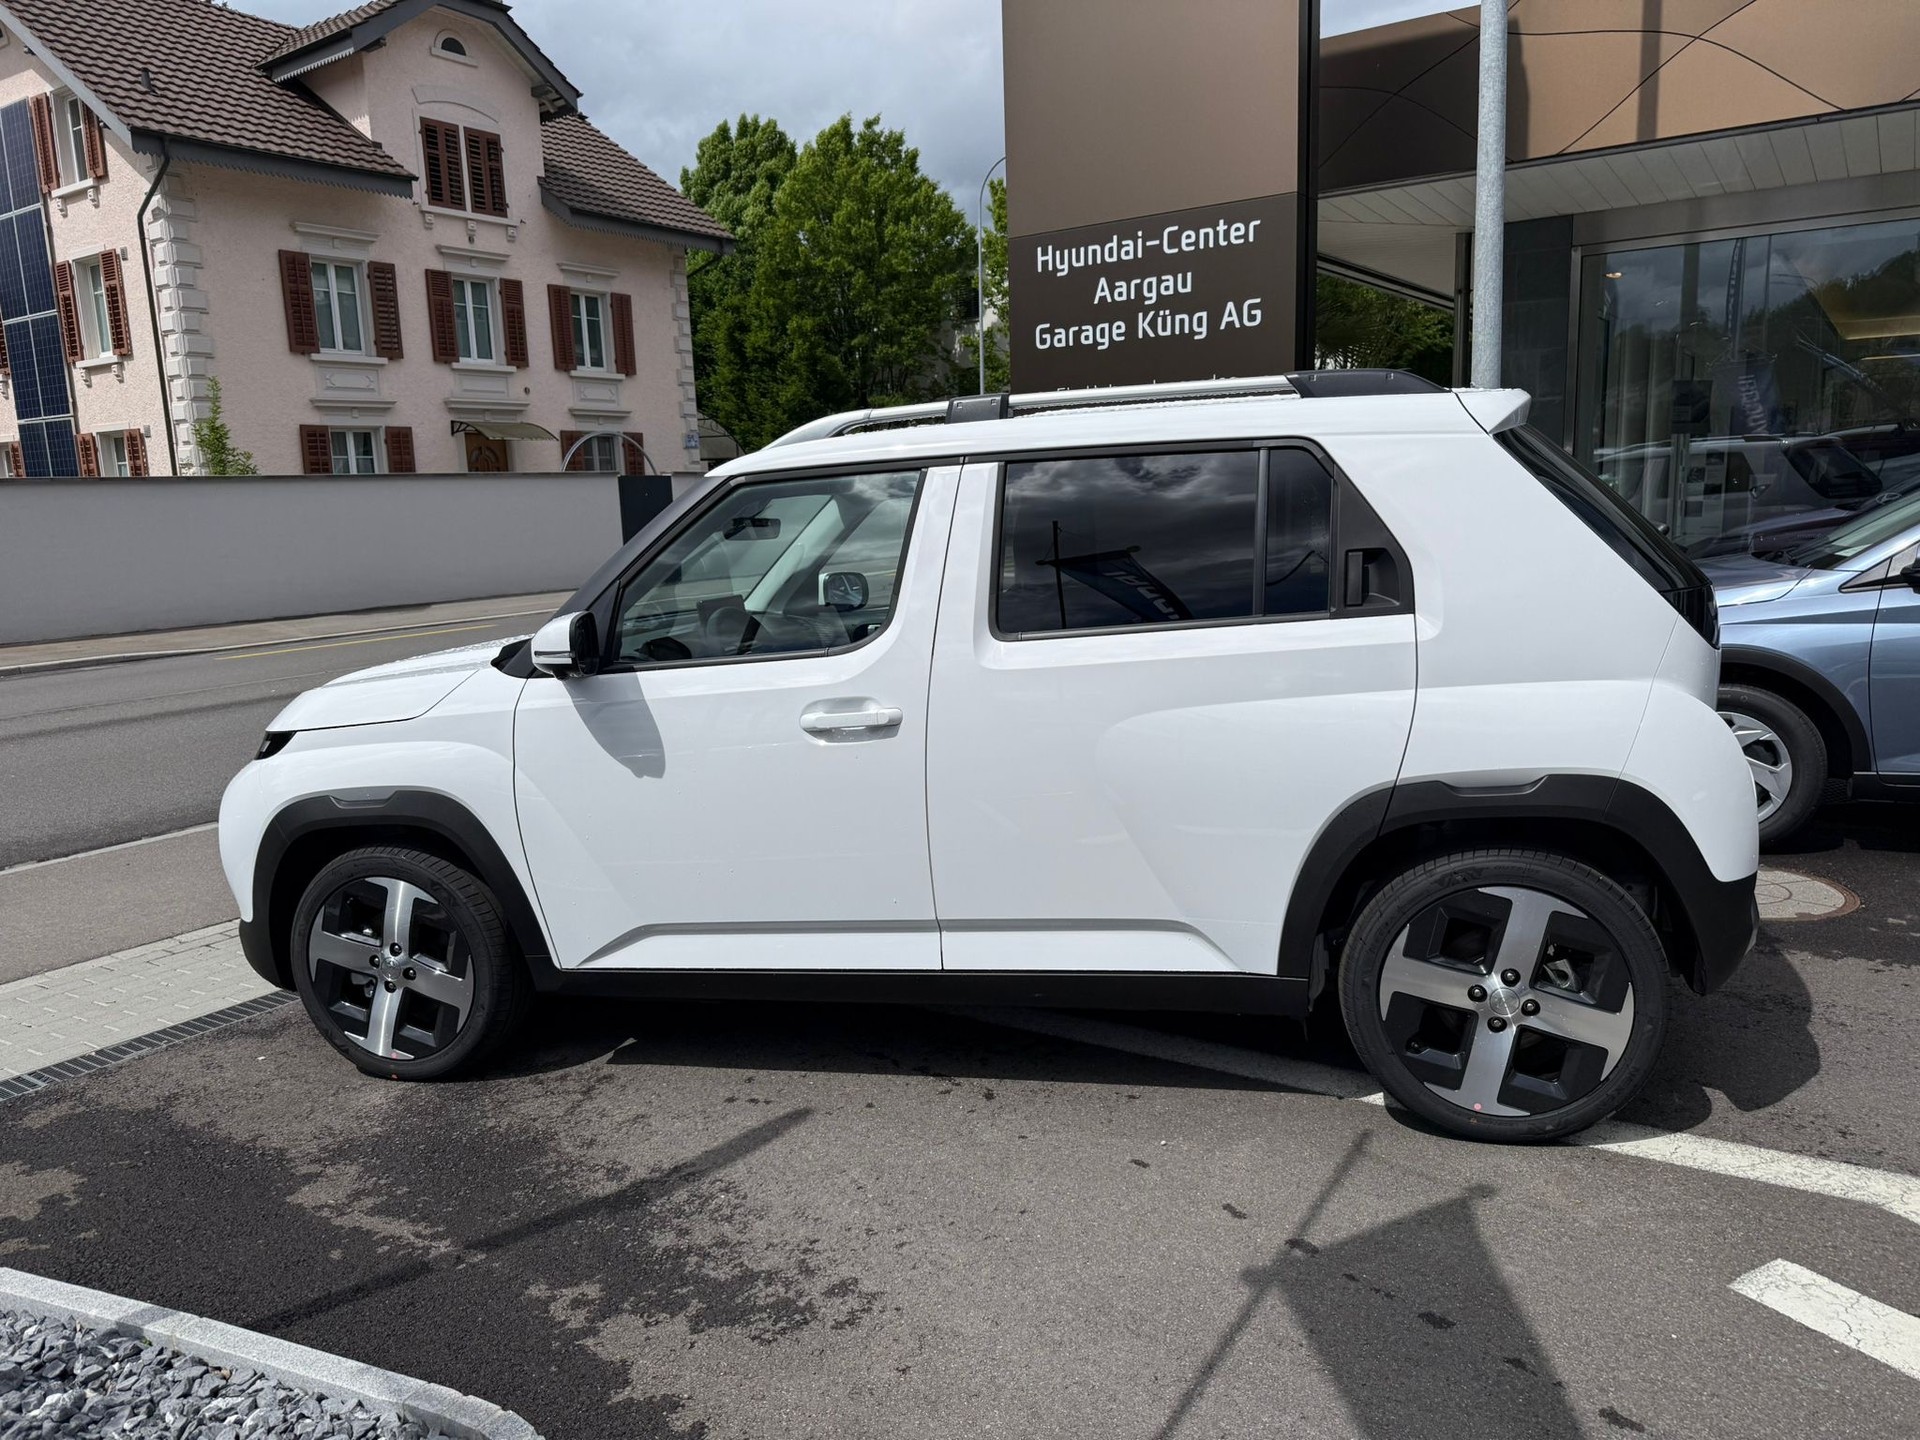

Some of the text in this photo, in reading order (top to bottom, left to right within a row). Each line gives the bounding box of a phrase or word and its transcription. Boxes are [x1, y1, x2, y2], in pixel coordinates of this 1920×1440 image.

[1036, 218, 1261, 277] Hyundai-Center
[1093, 271, 1192, 305] Aargau
[1035, 297, 1262, 351] Garage Küng AG
